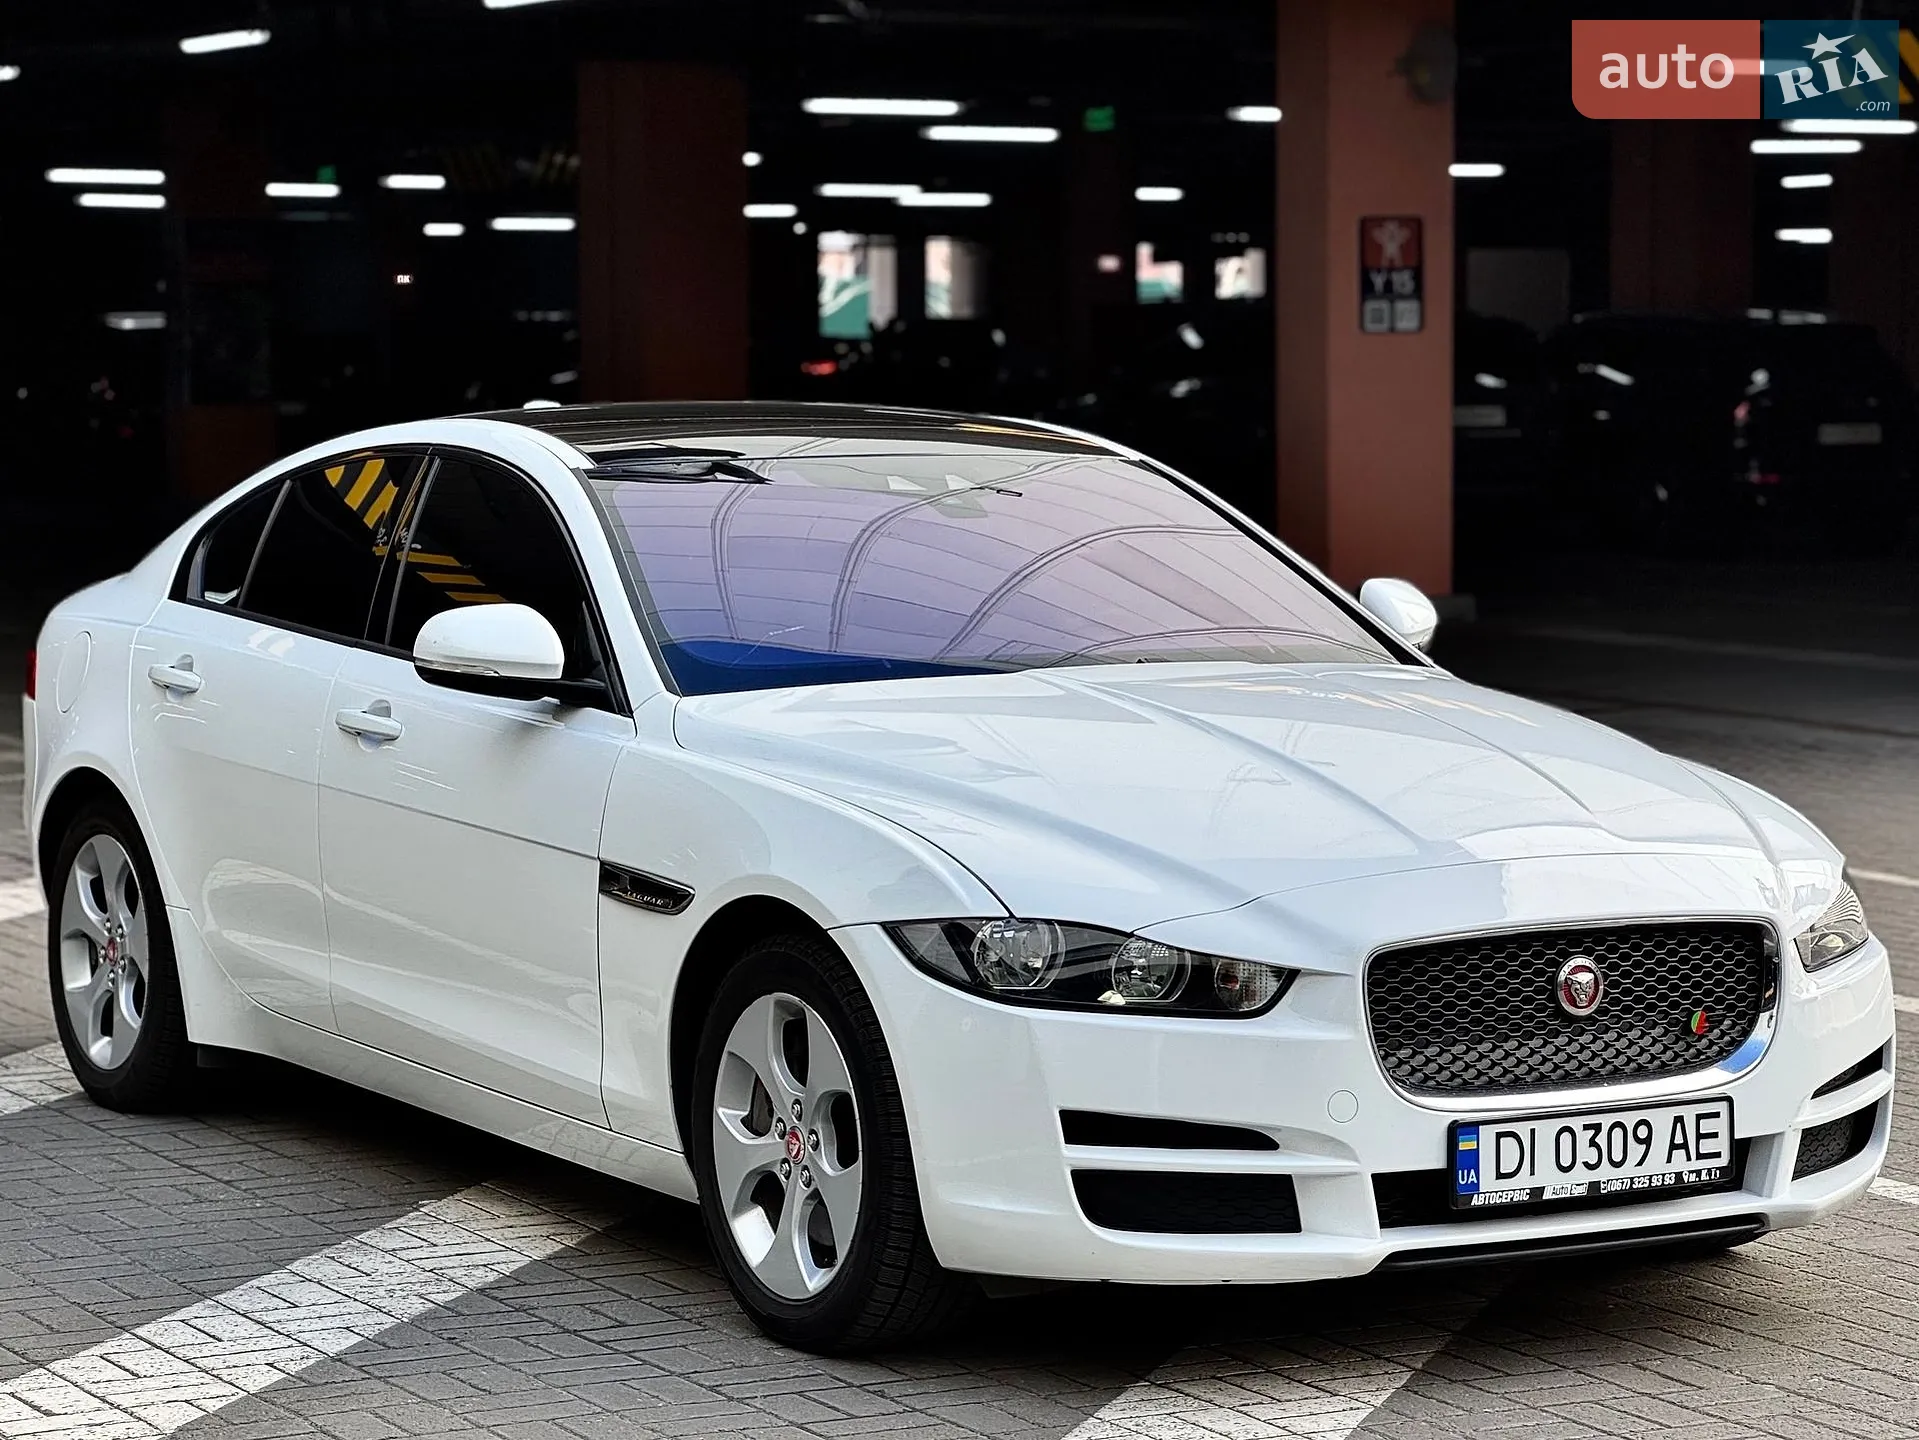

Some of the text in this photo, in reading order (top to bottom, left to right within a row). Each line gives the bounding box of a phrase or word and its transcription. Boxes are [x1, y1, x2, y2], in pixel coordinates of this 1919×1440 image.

[1495, 1112, 1722, 1180] DI 0309 AE
[1458, 1168, 1477, 1185] UA
[1632, 1176, 1650, 1188] 325
[1651, 1175, 1662, 1186] 93
[1664, 1173, 1676, 1184] 93
